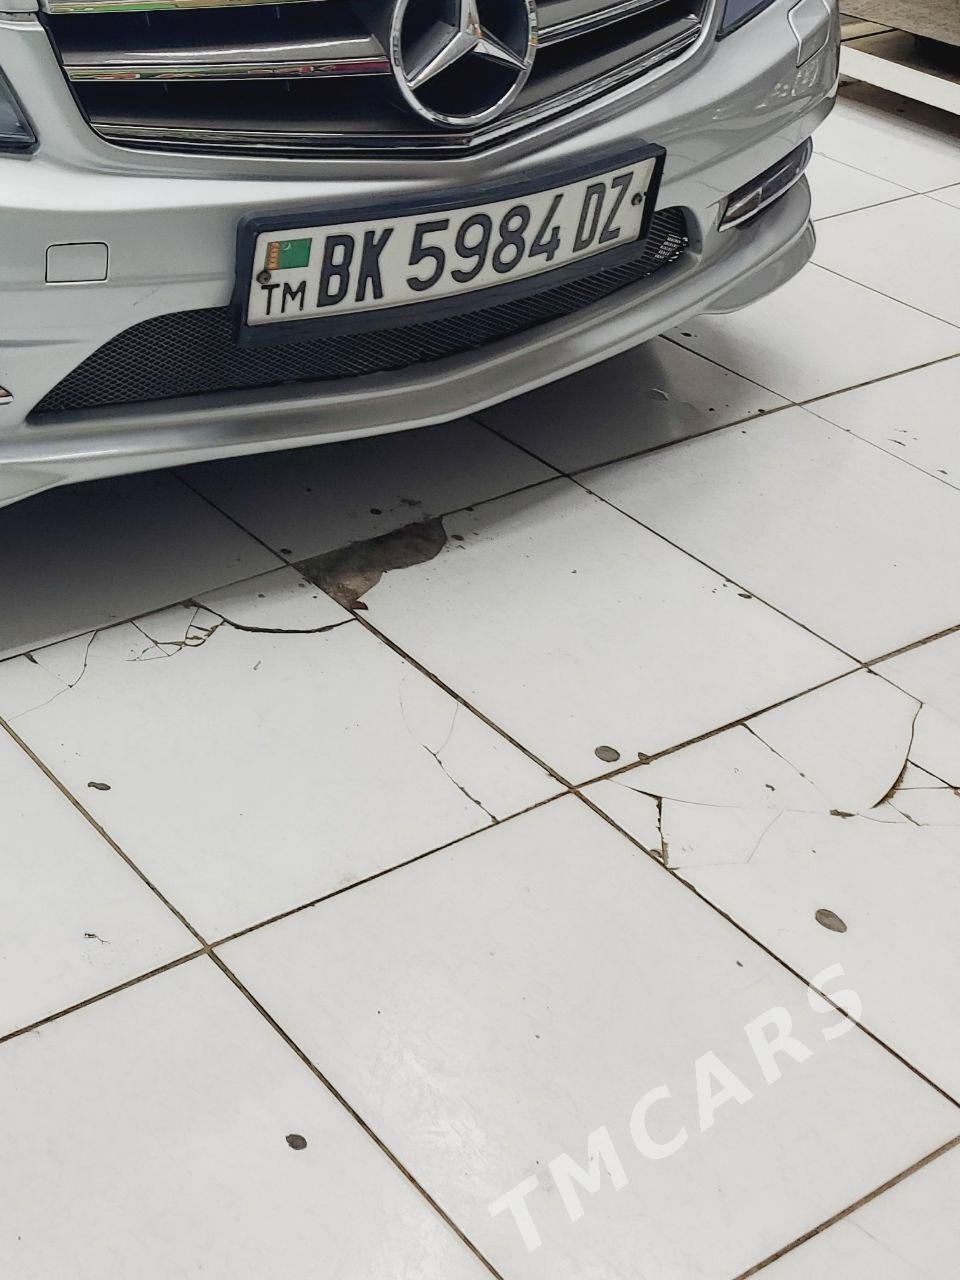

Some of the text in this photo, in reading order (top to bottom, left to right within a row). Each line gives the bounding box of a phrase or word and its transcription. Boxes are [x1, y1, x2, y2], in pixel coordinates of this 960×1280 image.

[317, 171, 634, 308] BK 5984 DZ
[261, 280, 307, 316] TM
